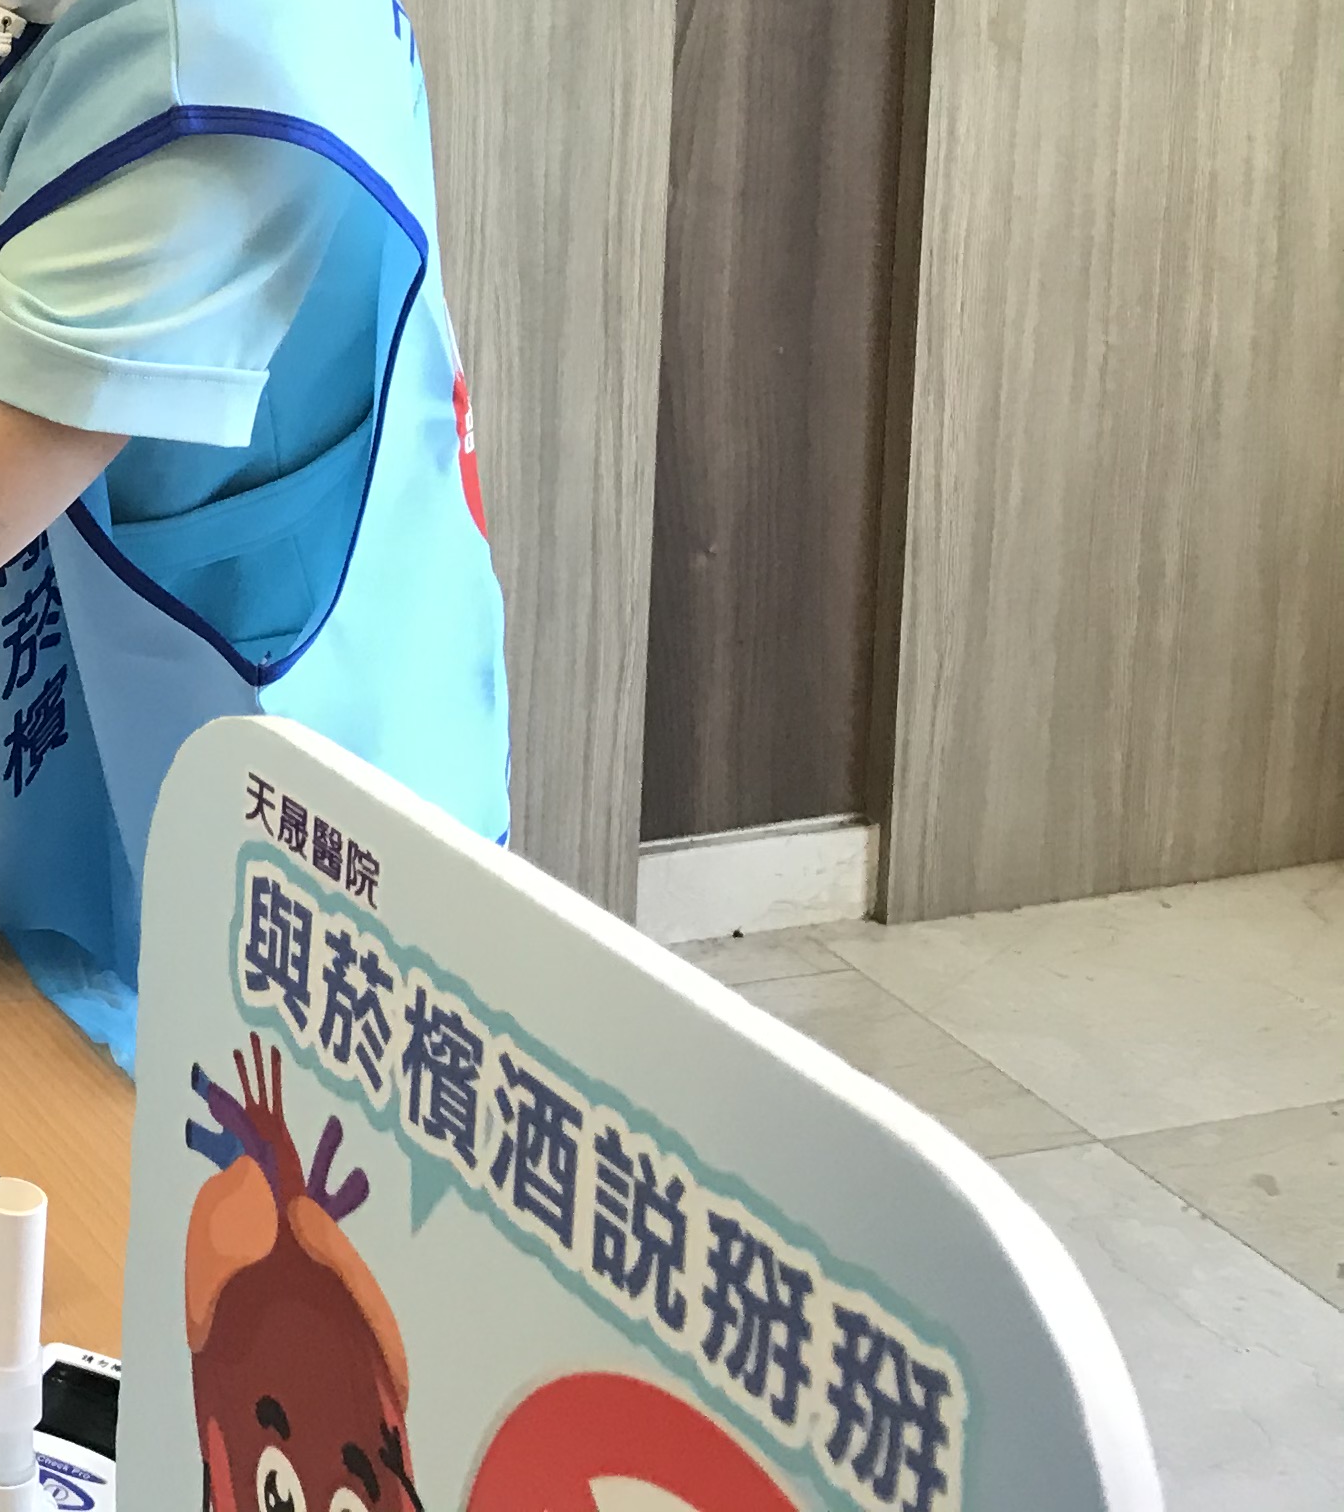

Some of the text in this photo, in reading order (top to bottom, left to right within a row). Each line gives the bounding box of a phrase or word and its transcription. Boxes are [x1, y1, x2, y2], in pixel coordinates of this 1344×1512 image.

[244, 772, 381, 910] 天晟醫院
[243, 875, 953, 1512] 與菸檳酒說掰掰
[71, 1467, 92, 1480] Pro
